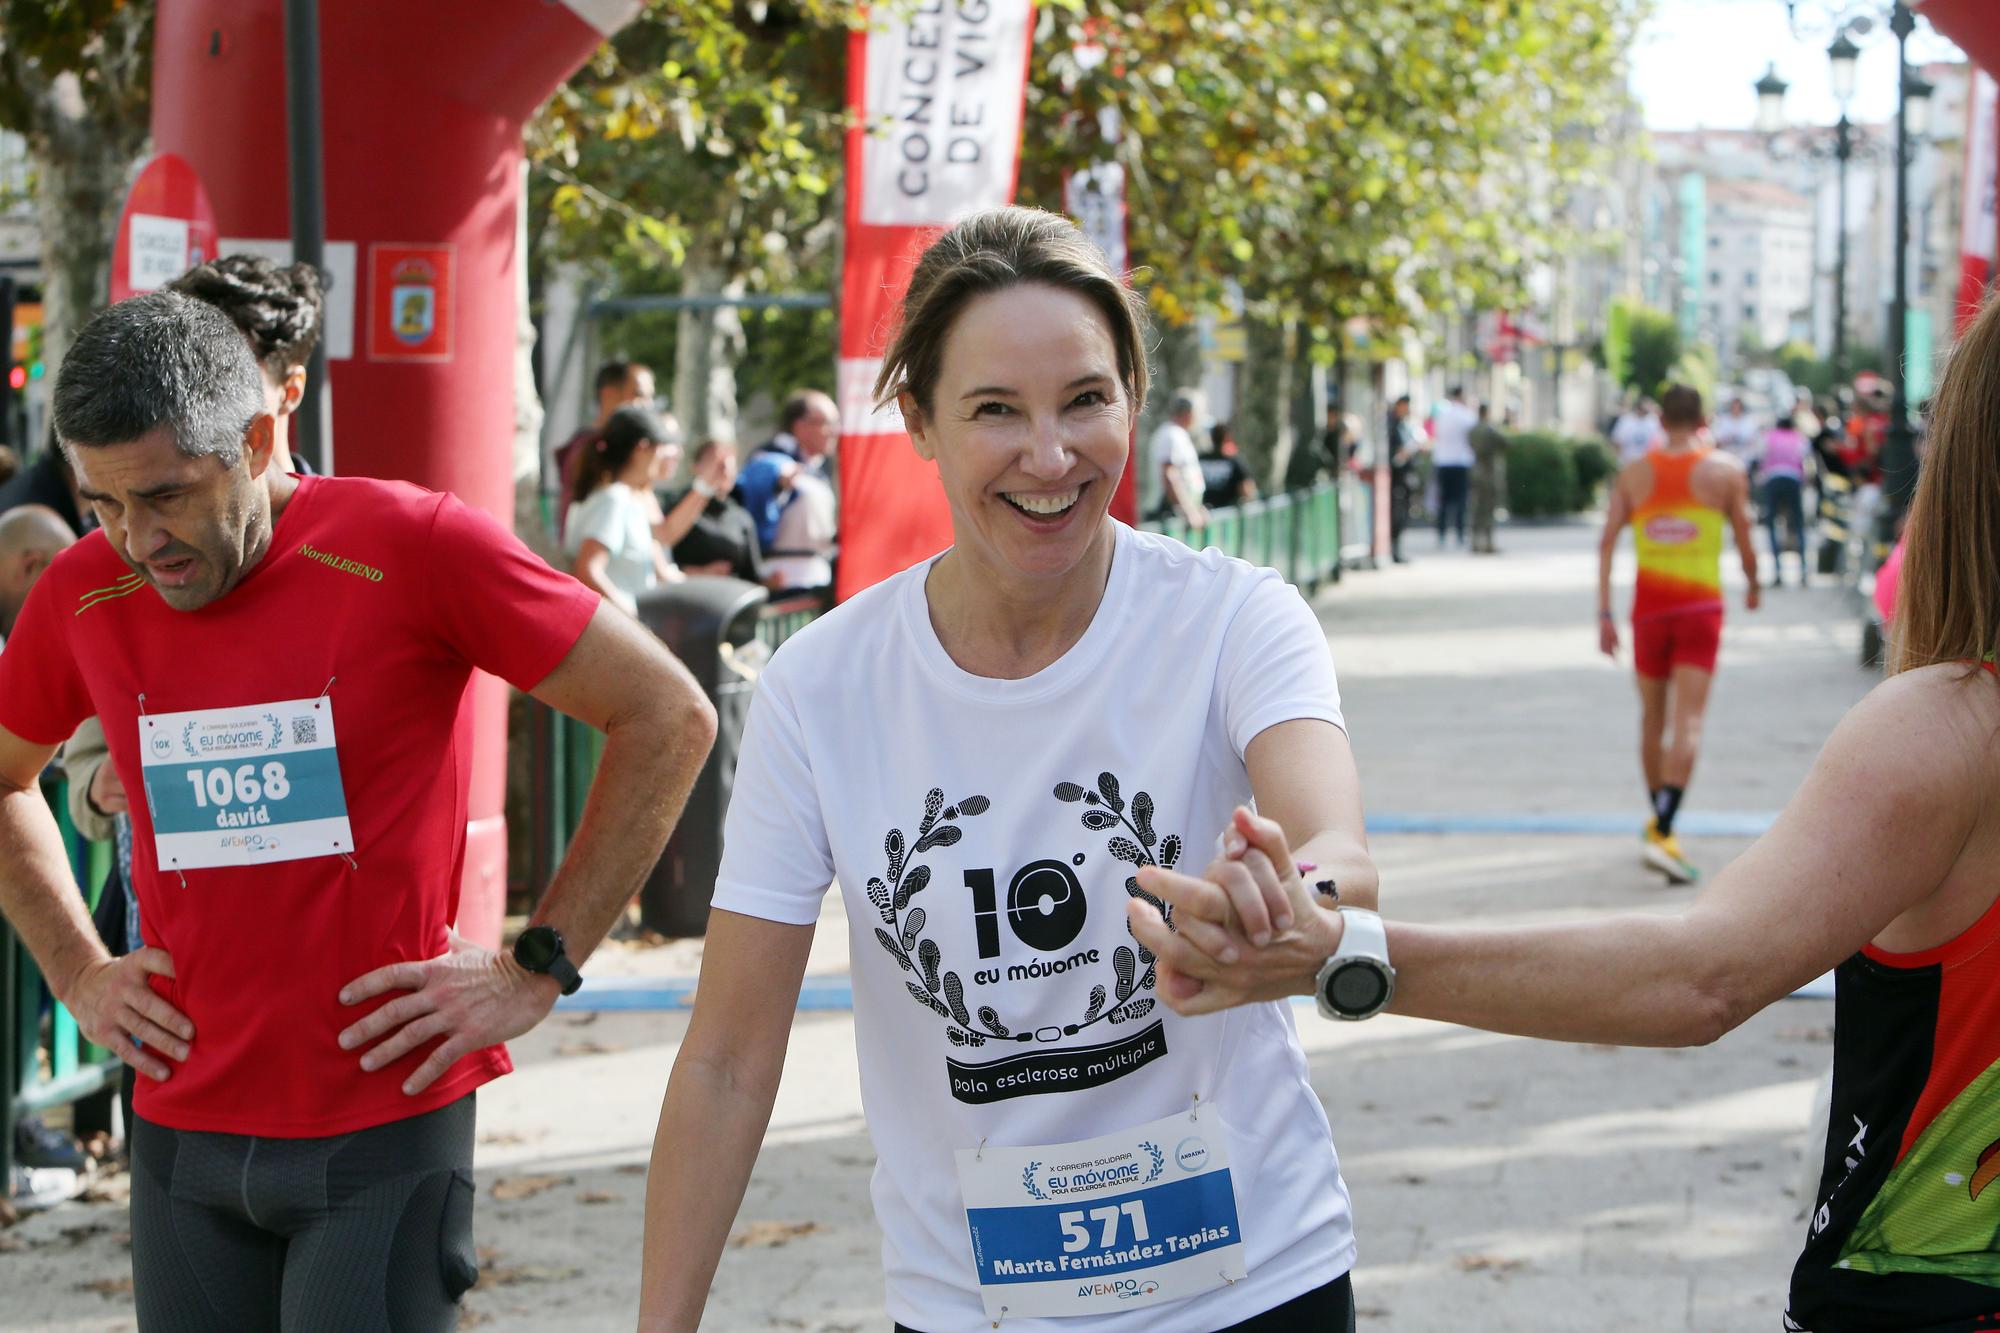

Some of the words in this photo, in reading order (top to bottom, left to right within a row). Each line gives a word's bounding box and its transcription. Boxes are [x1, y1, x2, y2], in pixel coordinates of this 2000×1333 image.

[947, 102, 983, 163] DE
[297, 543, 384, 582] NorthLEGEND
[154, 740, 170, 750] 10K
[199, 735, 214, 747] EU
[216, 730, 264, 746] MÓVOME
[186, 760, 291, 808] 1068
[216, 803, 271, 828] david
[220, 834, 263, 848] AVEMPO
[973, 967, 1001, 986] eu
[1007, 948, 1101, 982] móvome
[996, 1066, 1079, 1089] esclerose
[1087, 1040, 1156, 1077] múltiple
[1056, 1161, 1093, 1172] CARREIRA
[1094, 1152, 1133, 1167] SOLIDARIA
[1048, 1176, 1068, 1189] EU
[1072, 1163, 1140, 1187] MÓVOME
[1070, 1182, 1107, 1193] ESCLEROSE
[1058, 1199, 1150, 1253] 571
[993, 1255, 1057, 1276] Marta
[1059, 1242, 1164, 1272] Fernández
[1165, 1225, 1231, 1253] Tapias
[1077, 1278, 1138, 1298] AVEMPO
